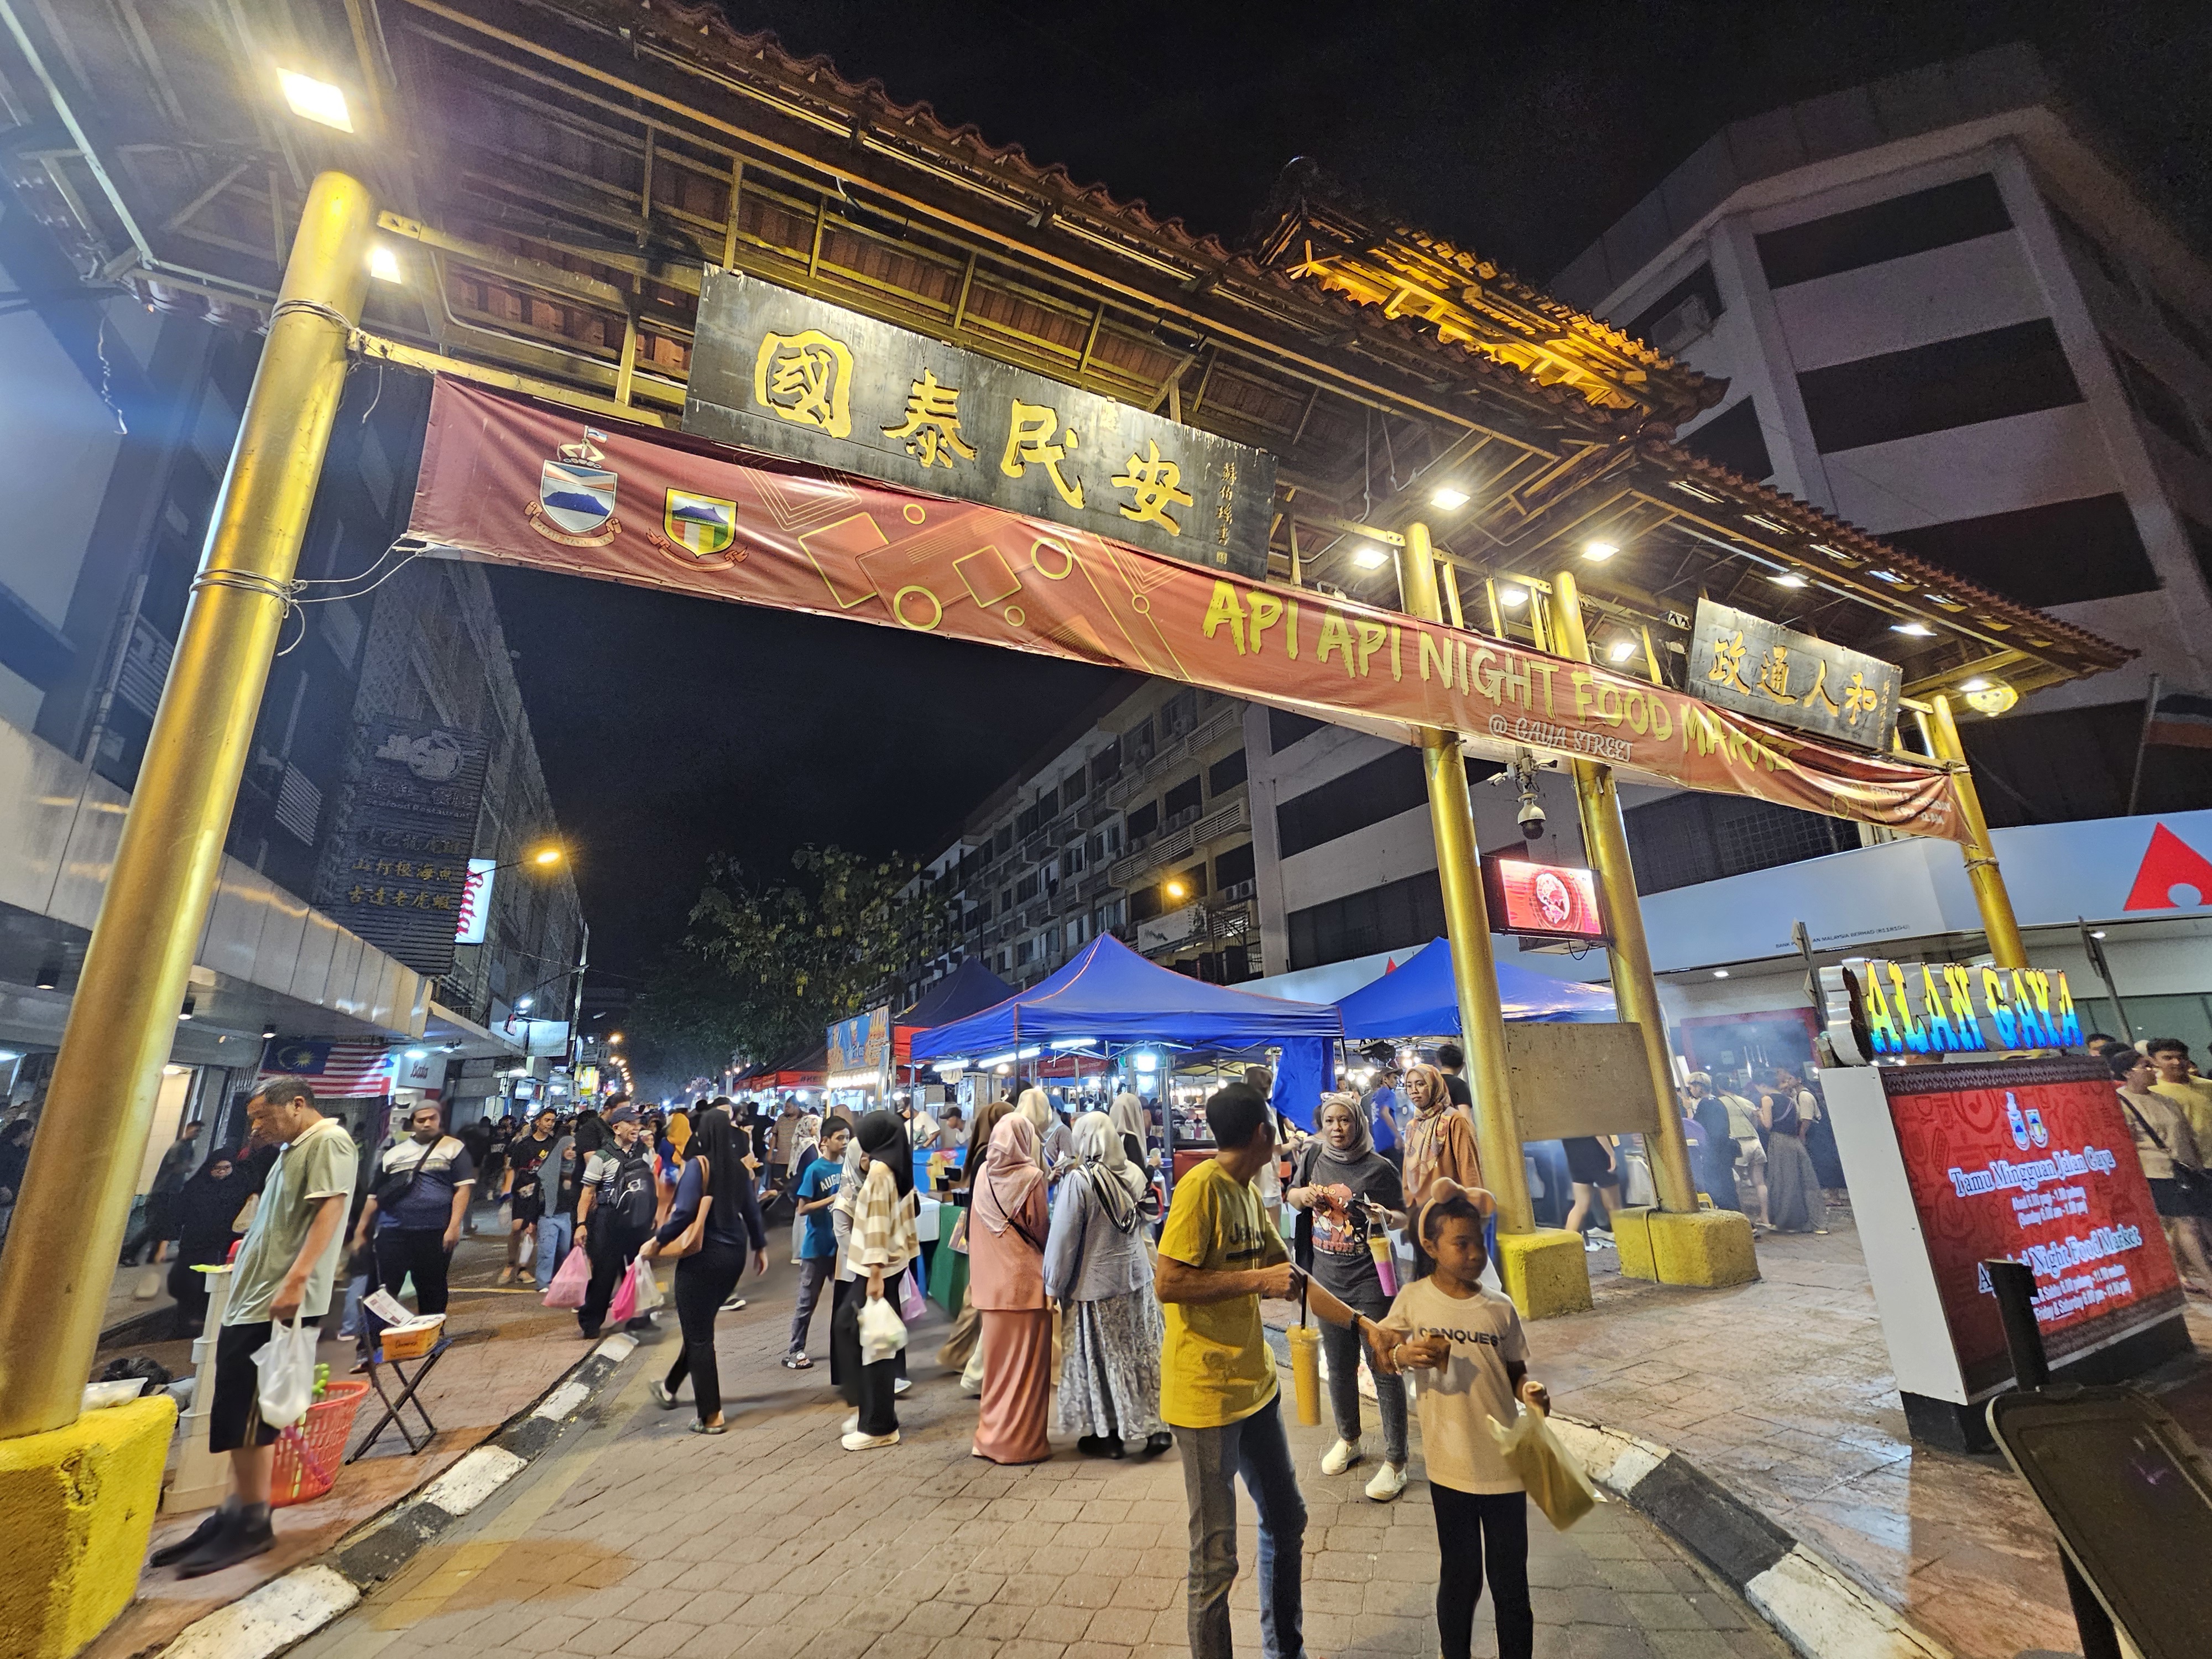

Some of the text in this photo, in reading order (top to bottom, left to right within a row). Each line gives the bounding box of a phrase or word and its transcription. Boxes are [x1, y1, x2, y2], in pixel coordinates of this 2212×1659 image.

[754, 328, 1193, 538] 國泰民安
[1202, 580, 1298, 660] API
[1317, 606, 1402, 682] API
[1419, 631, 1560, 719] NIGHT
[1571, 670, 1673, 742] FOOD
[1708, 630, 1877, 725] 政通人和
[1488, 713, 1633, 763] @ GAYA STREET
[457, 867, 484, 935] Bata
[1822, 933, 1849, 941] MALAYSIA
[1851, 929, 1875, 937] BERHAD
[1981, 967, 2084, 1049] GAYA
[410, 1060, 429, 1079] Bata
[820, 1173, 841, 1192] AUGU
[1950, 1147, 2115, 1195] Tamu Mingguan Jalan Gaya
[2029, 1242, 2070, 1277] Night
[2066, 1230, 2103, 1264] Food
[2098, 1224, 2141, 1255] Market
